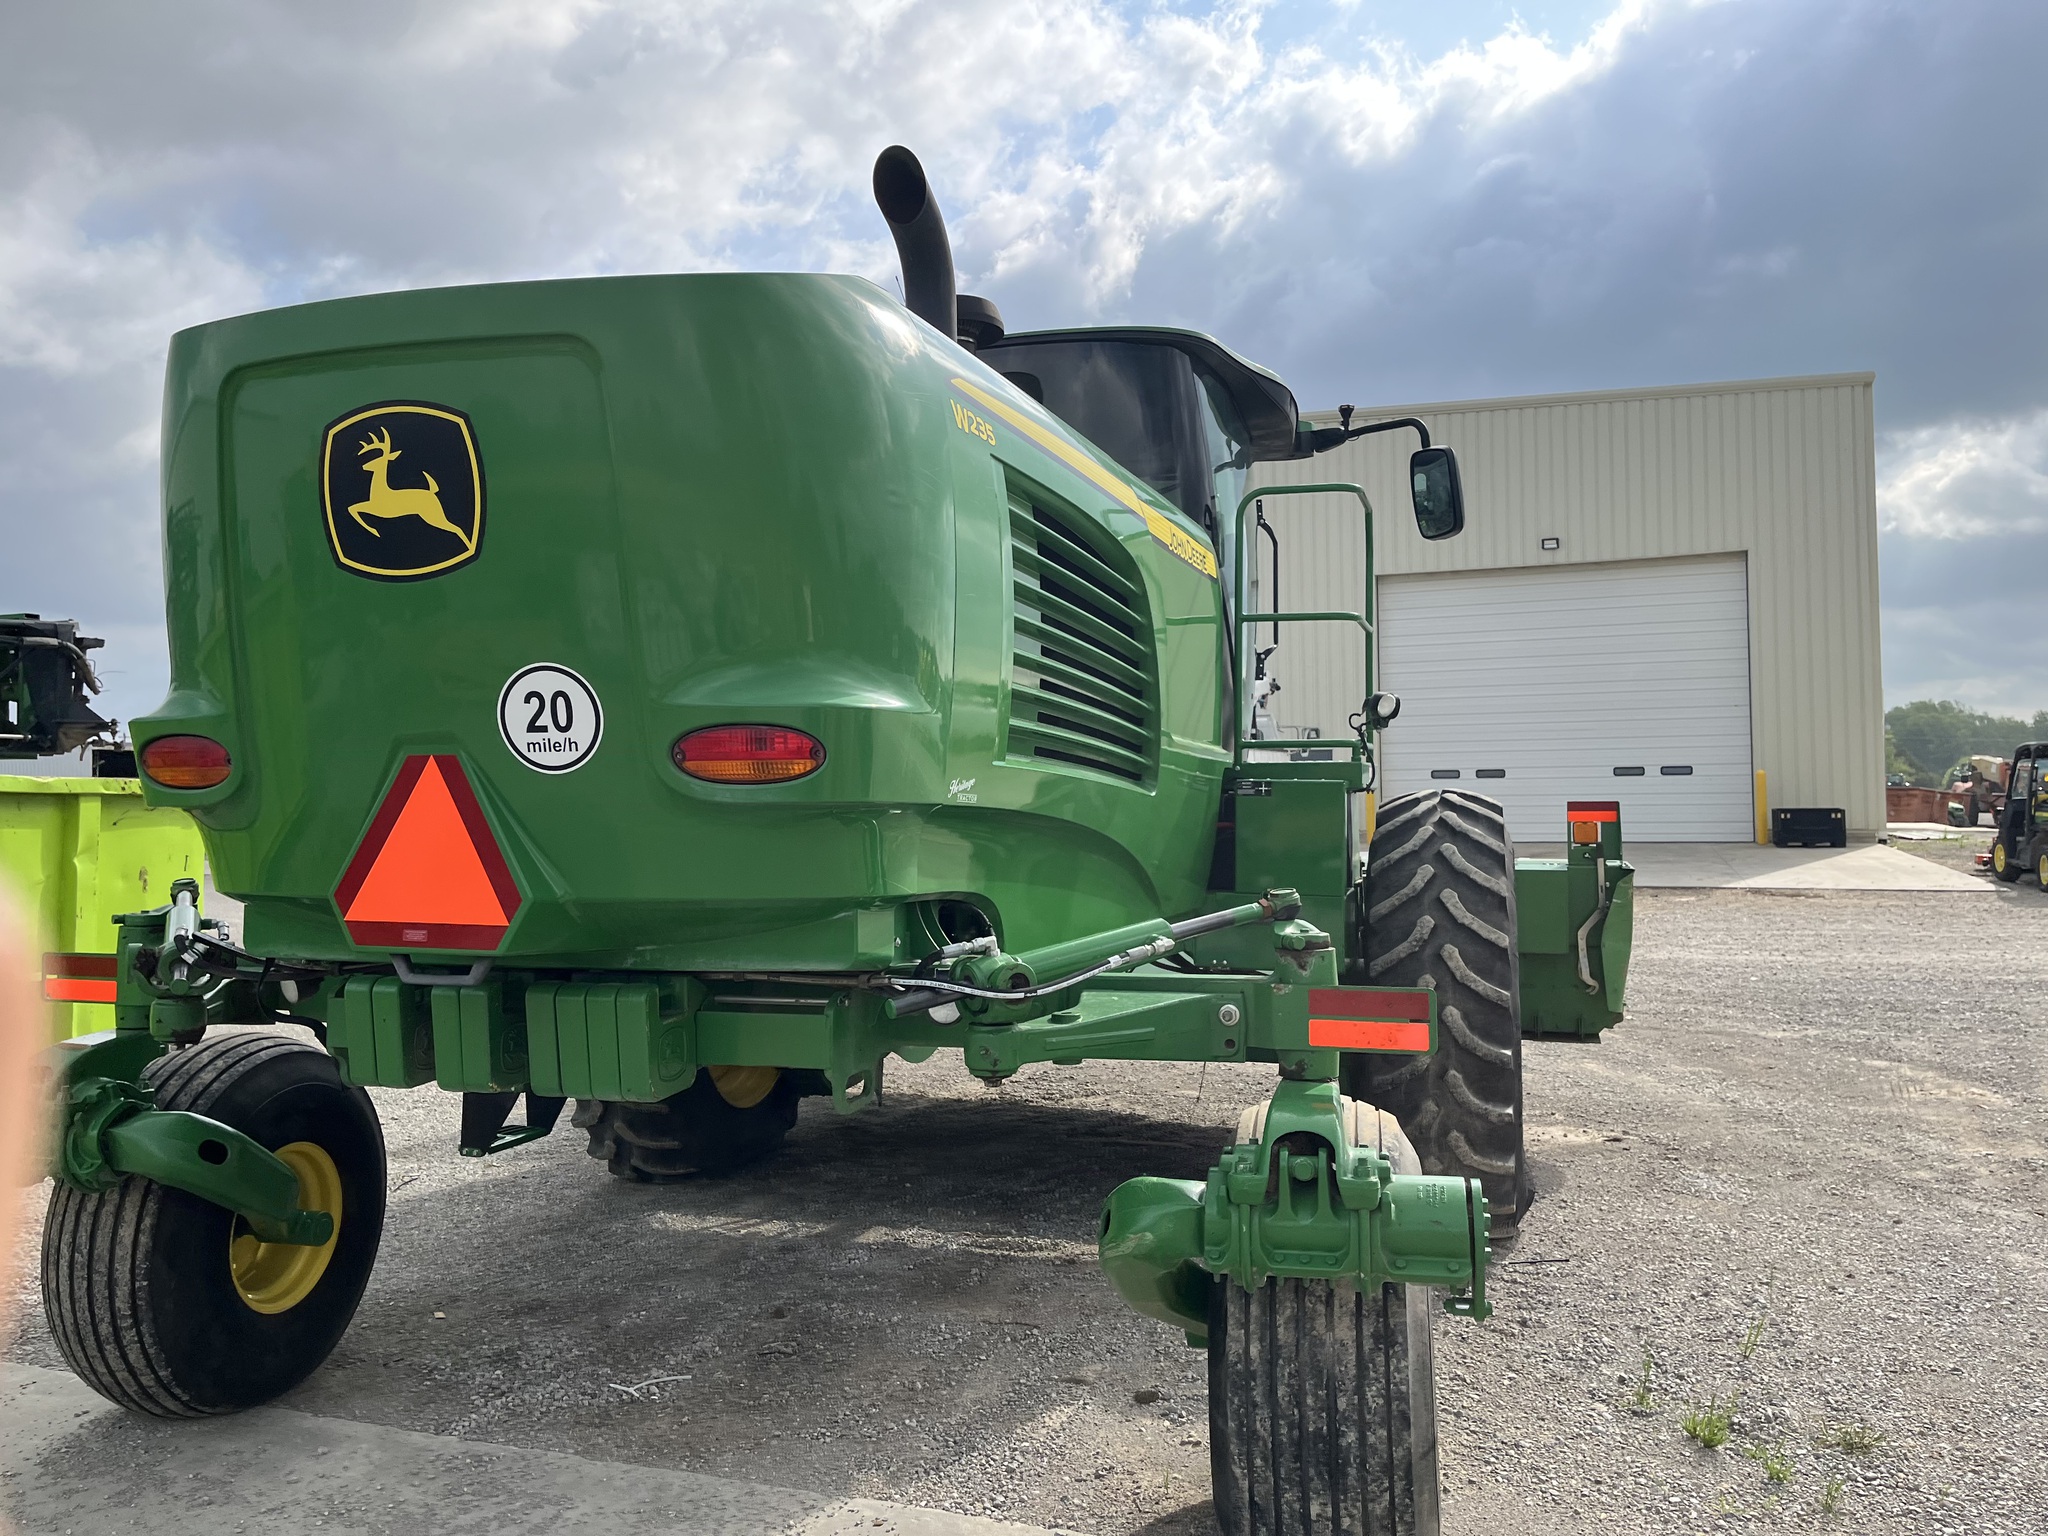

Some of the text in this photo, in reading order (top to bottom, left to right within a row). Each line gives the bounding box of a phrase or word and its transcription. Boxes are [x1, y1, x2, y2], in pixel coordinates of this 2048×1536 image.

[949, 398, 996, 446] W235
[1169, 527, 1208, 573] JOHN DEERE
[523, 690, 574, 734] 20
[526, 737, 579, 753] mile/h
